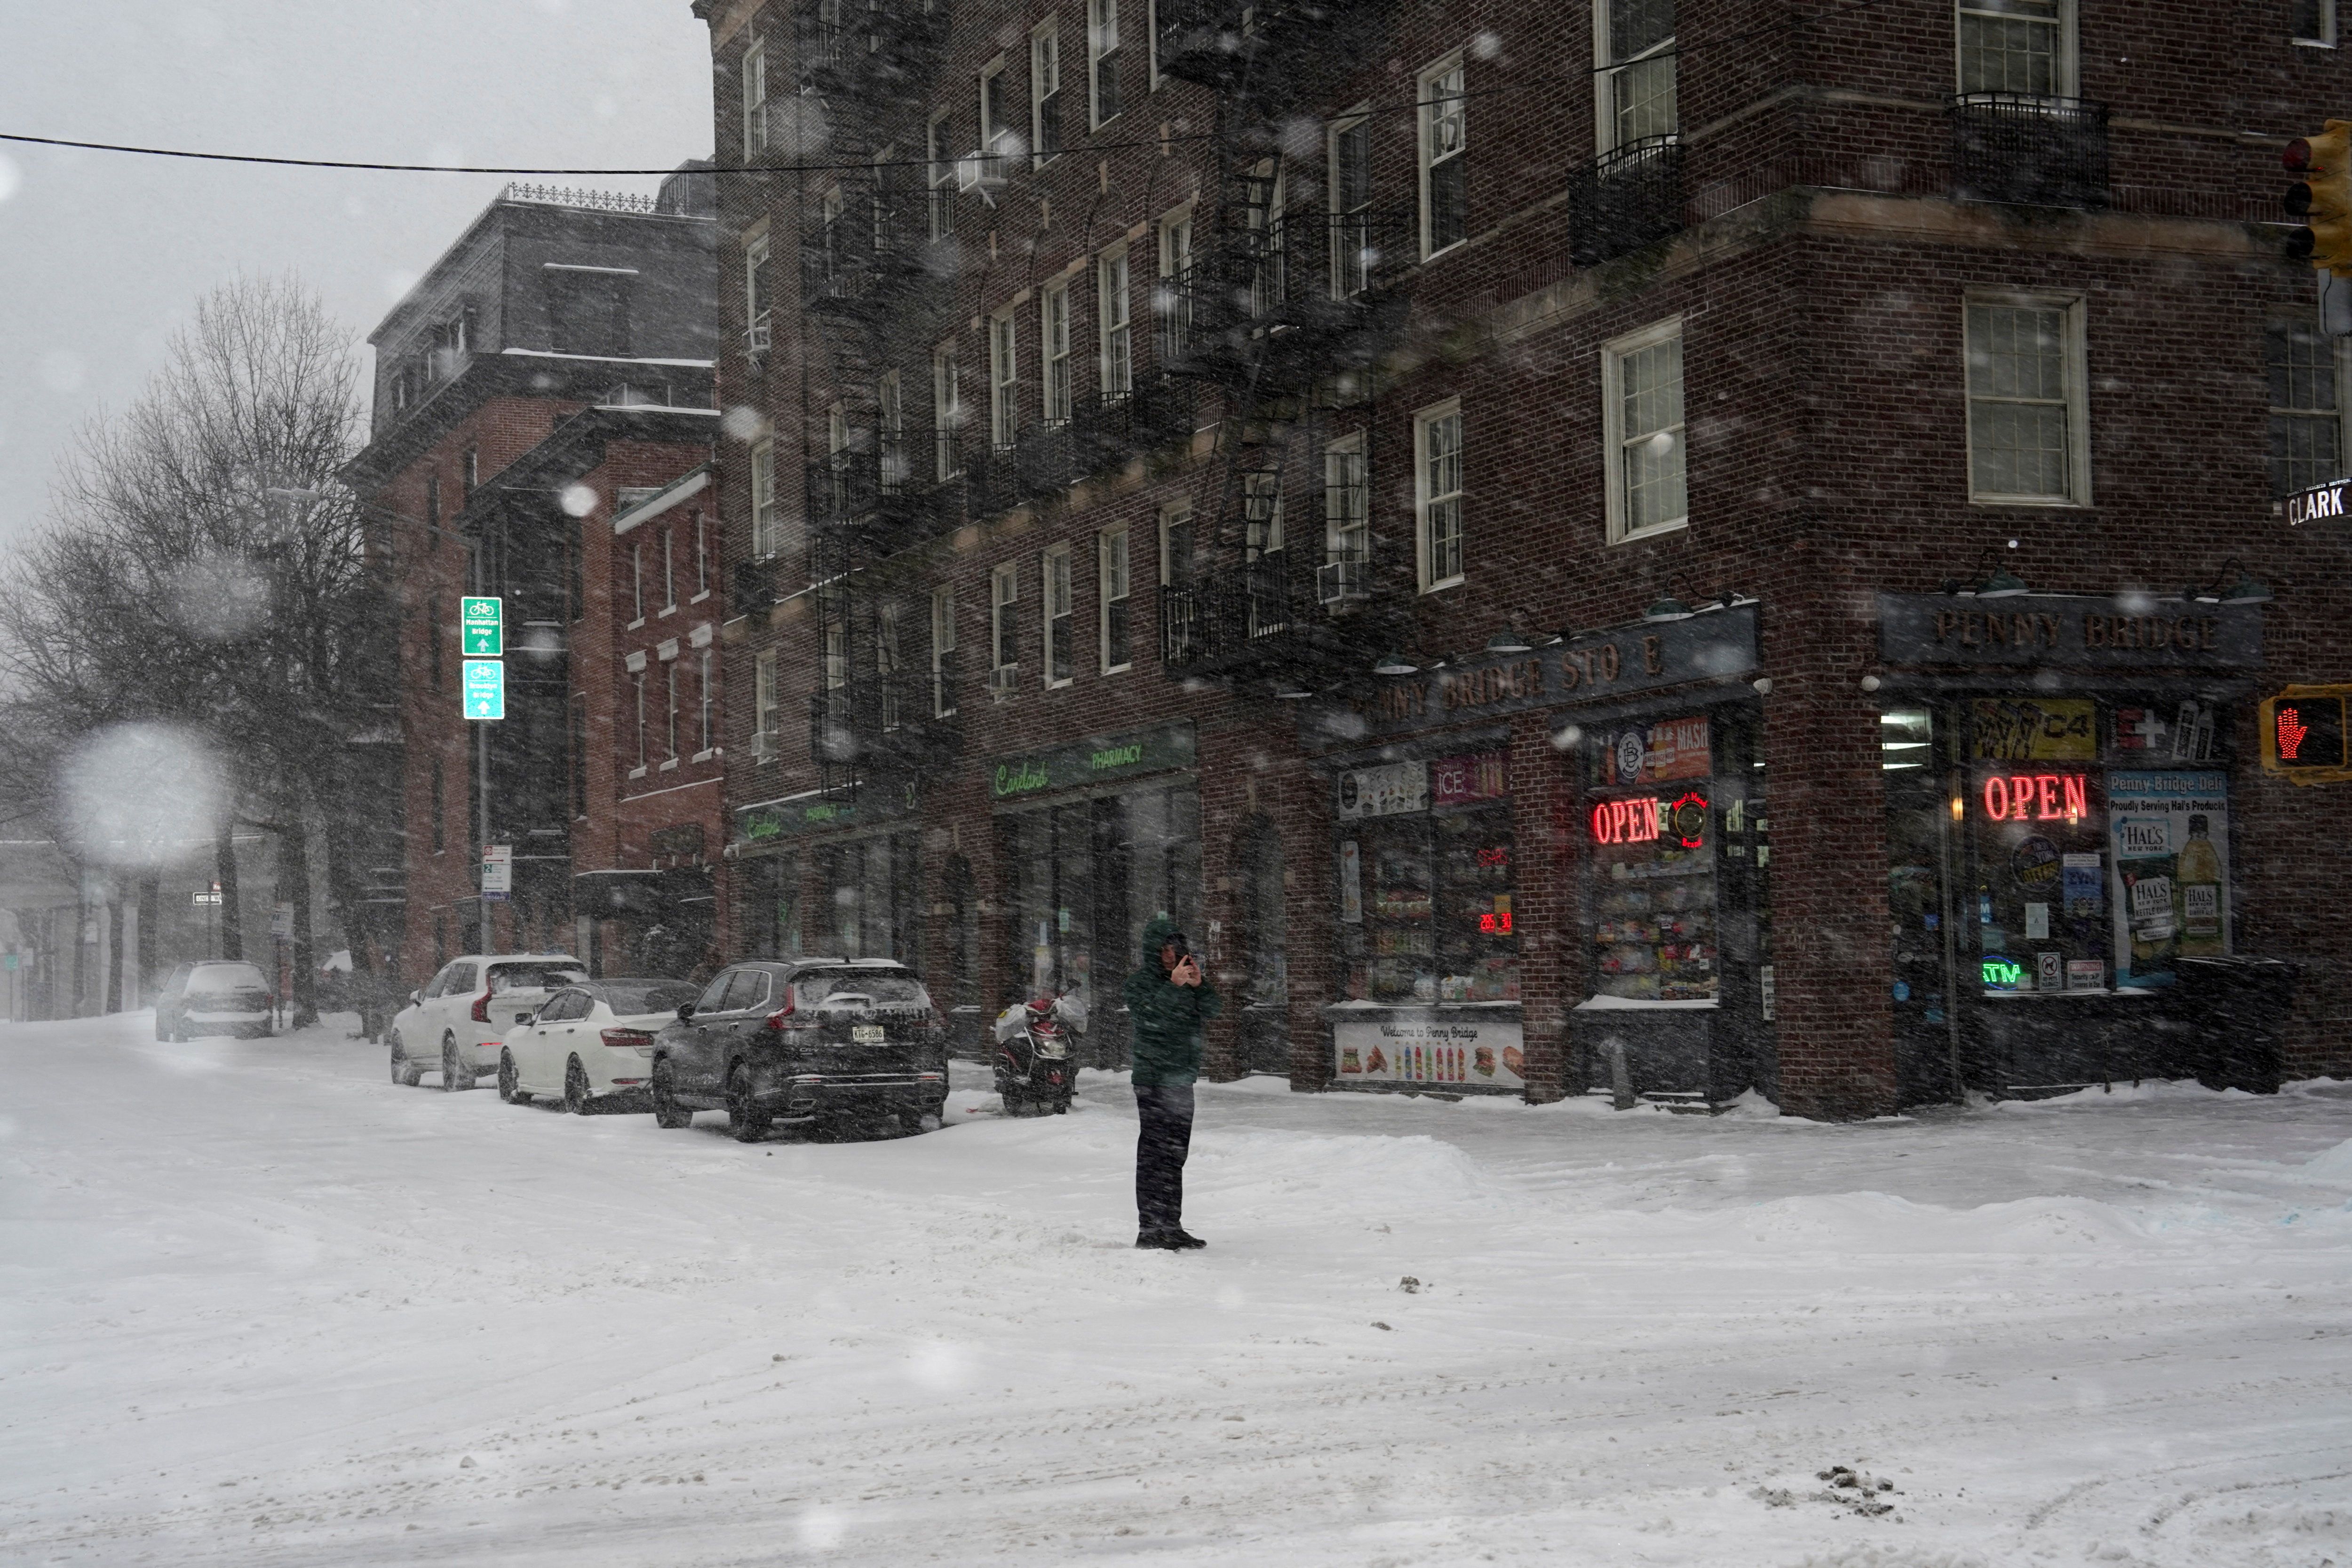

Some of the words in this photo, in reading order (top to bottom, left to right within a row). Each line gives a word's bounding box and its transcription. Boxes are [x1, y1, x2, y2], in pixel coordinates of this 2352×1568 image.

[2289, 488, 2343, 525] CLARK
[1936, 611, 2063, 648] PENNY
[2085, 613, 2218, 650] BRIDGE
[1438, 658, 1544, 710] BRIDGE
[1677, 722, 1708, 751] MASH
[2044, 714, 2090, 738] C4
[996, 761, 1049, 796] Careland
[1092, 744, 1142, 769] PHARMACY
[1438, 770, 1463, 795] ICE
[1985, 774, 2088, 821] OPEN
[2110, 776, 2150, 794] Penny
[2154, 776, 2194, 795] Bridge
[2199, 776, 2222, 791] Deli
[1594, 797, 1659, 844] OPEN
[2110, 800, 2139, 813] Proudly
[2141, 800, 2169, 813] Serving
[2171, 800, 2190, 811] Hal's
[2192, 800, 2225, 811] Products
[2136, 907, 2155, 917] KETTLE
[2156, 905, 2171, 914] CHIPS
[1381, 1026, 1415, 1037] Welcome
[1417, 1028, 1423, 1037] to
[1426, 1026, 1449, 1041] Penny
[1451, 1026, 1478, 1042] Bridge
